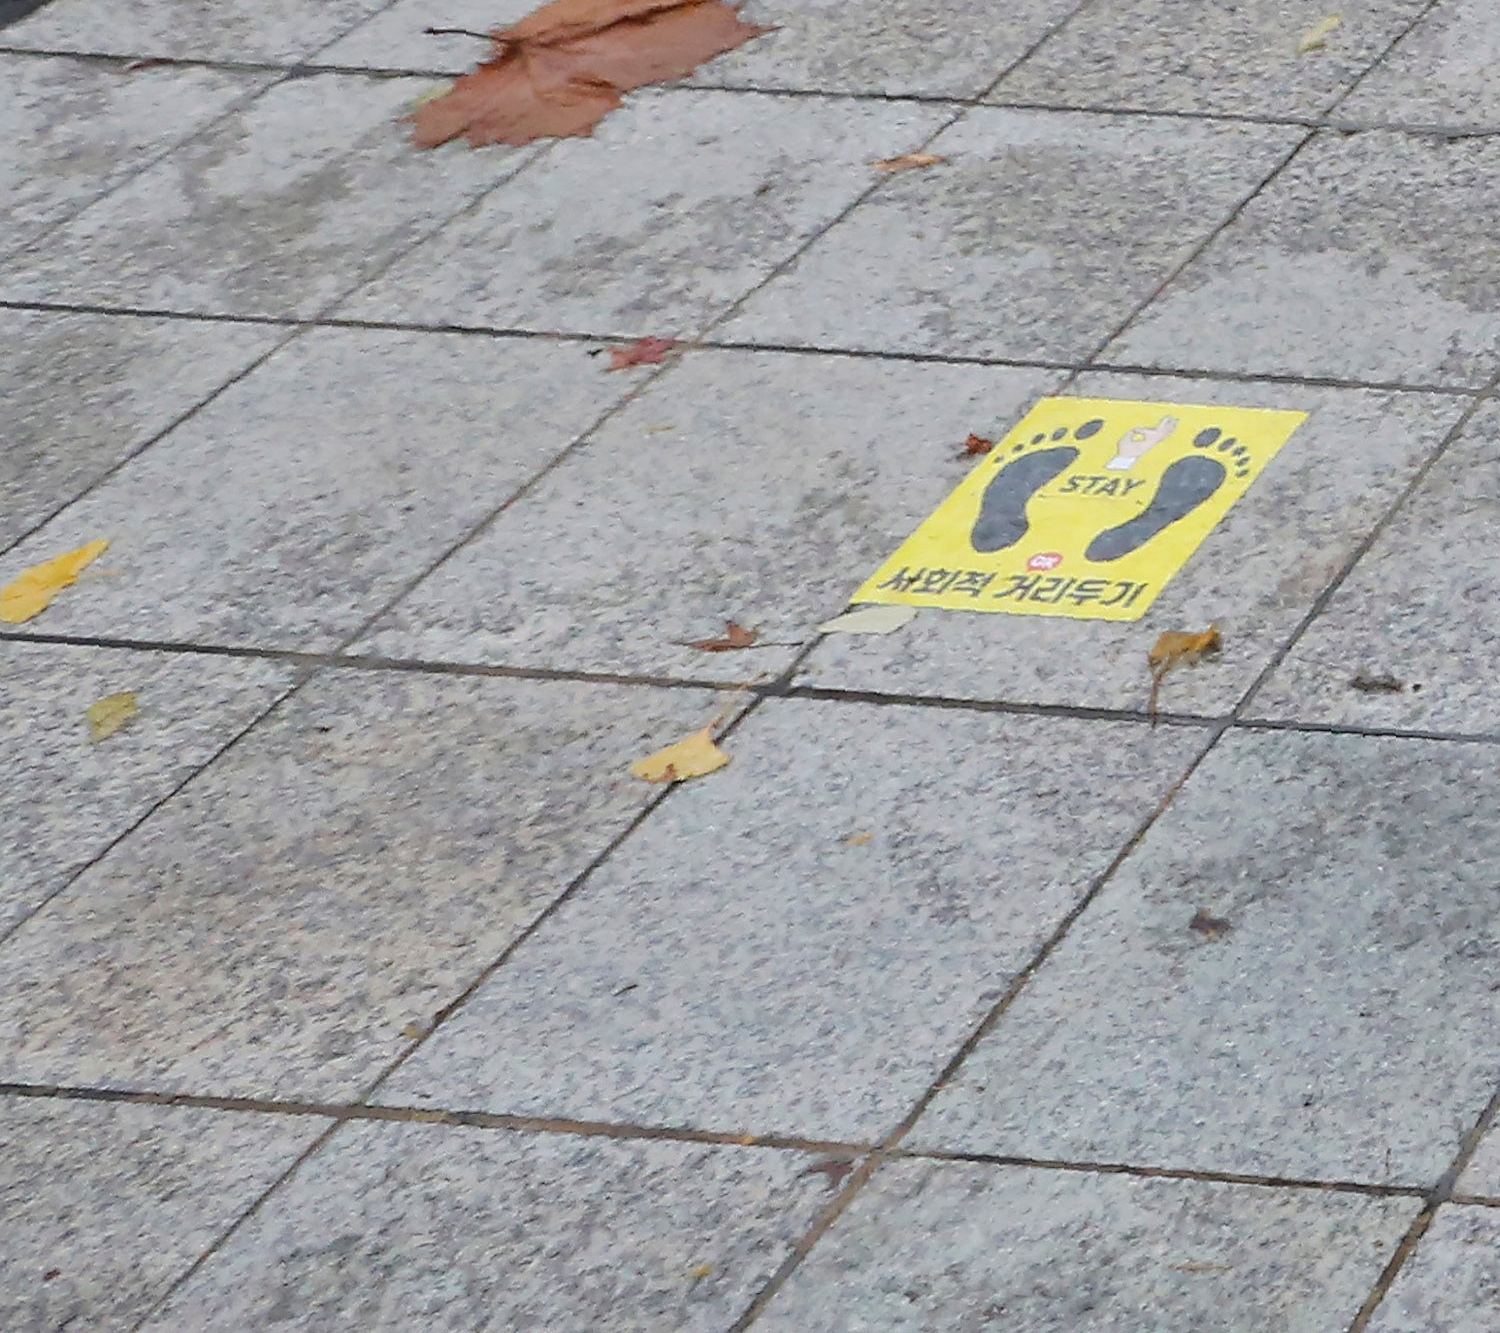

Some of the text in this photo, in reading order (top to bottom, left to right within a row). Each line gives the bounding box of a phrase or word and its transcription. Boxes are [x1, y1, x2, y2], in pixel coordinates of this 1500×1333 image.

[1057, 475, 1147, 497] STAY
[876, 567, 1149, 608] 사회적 거리두기
